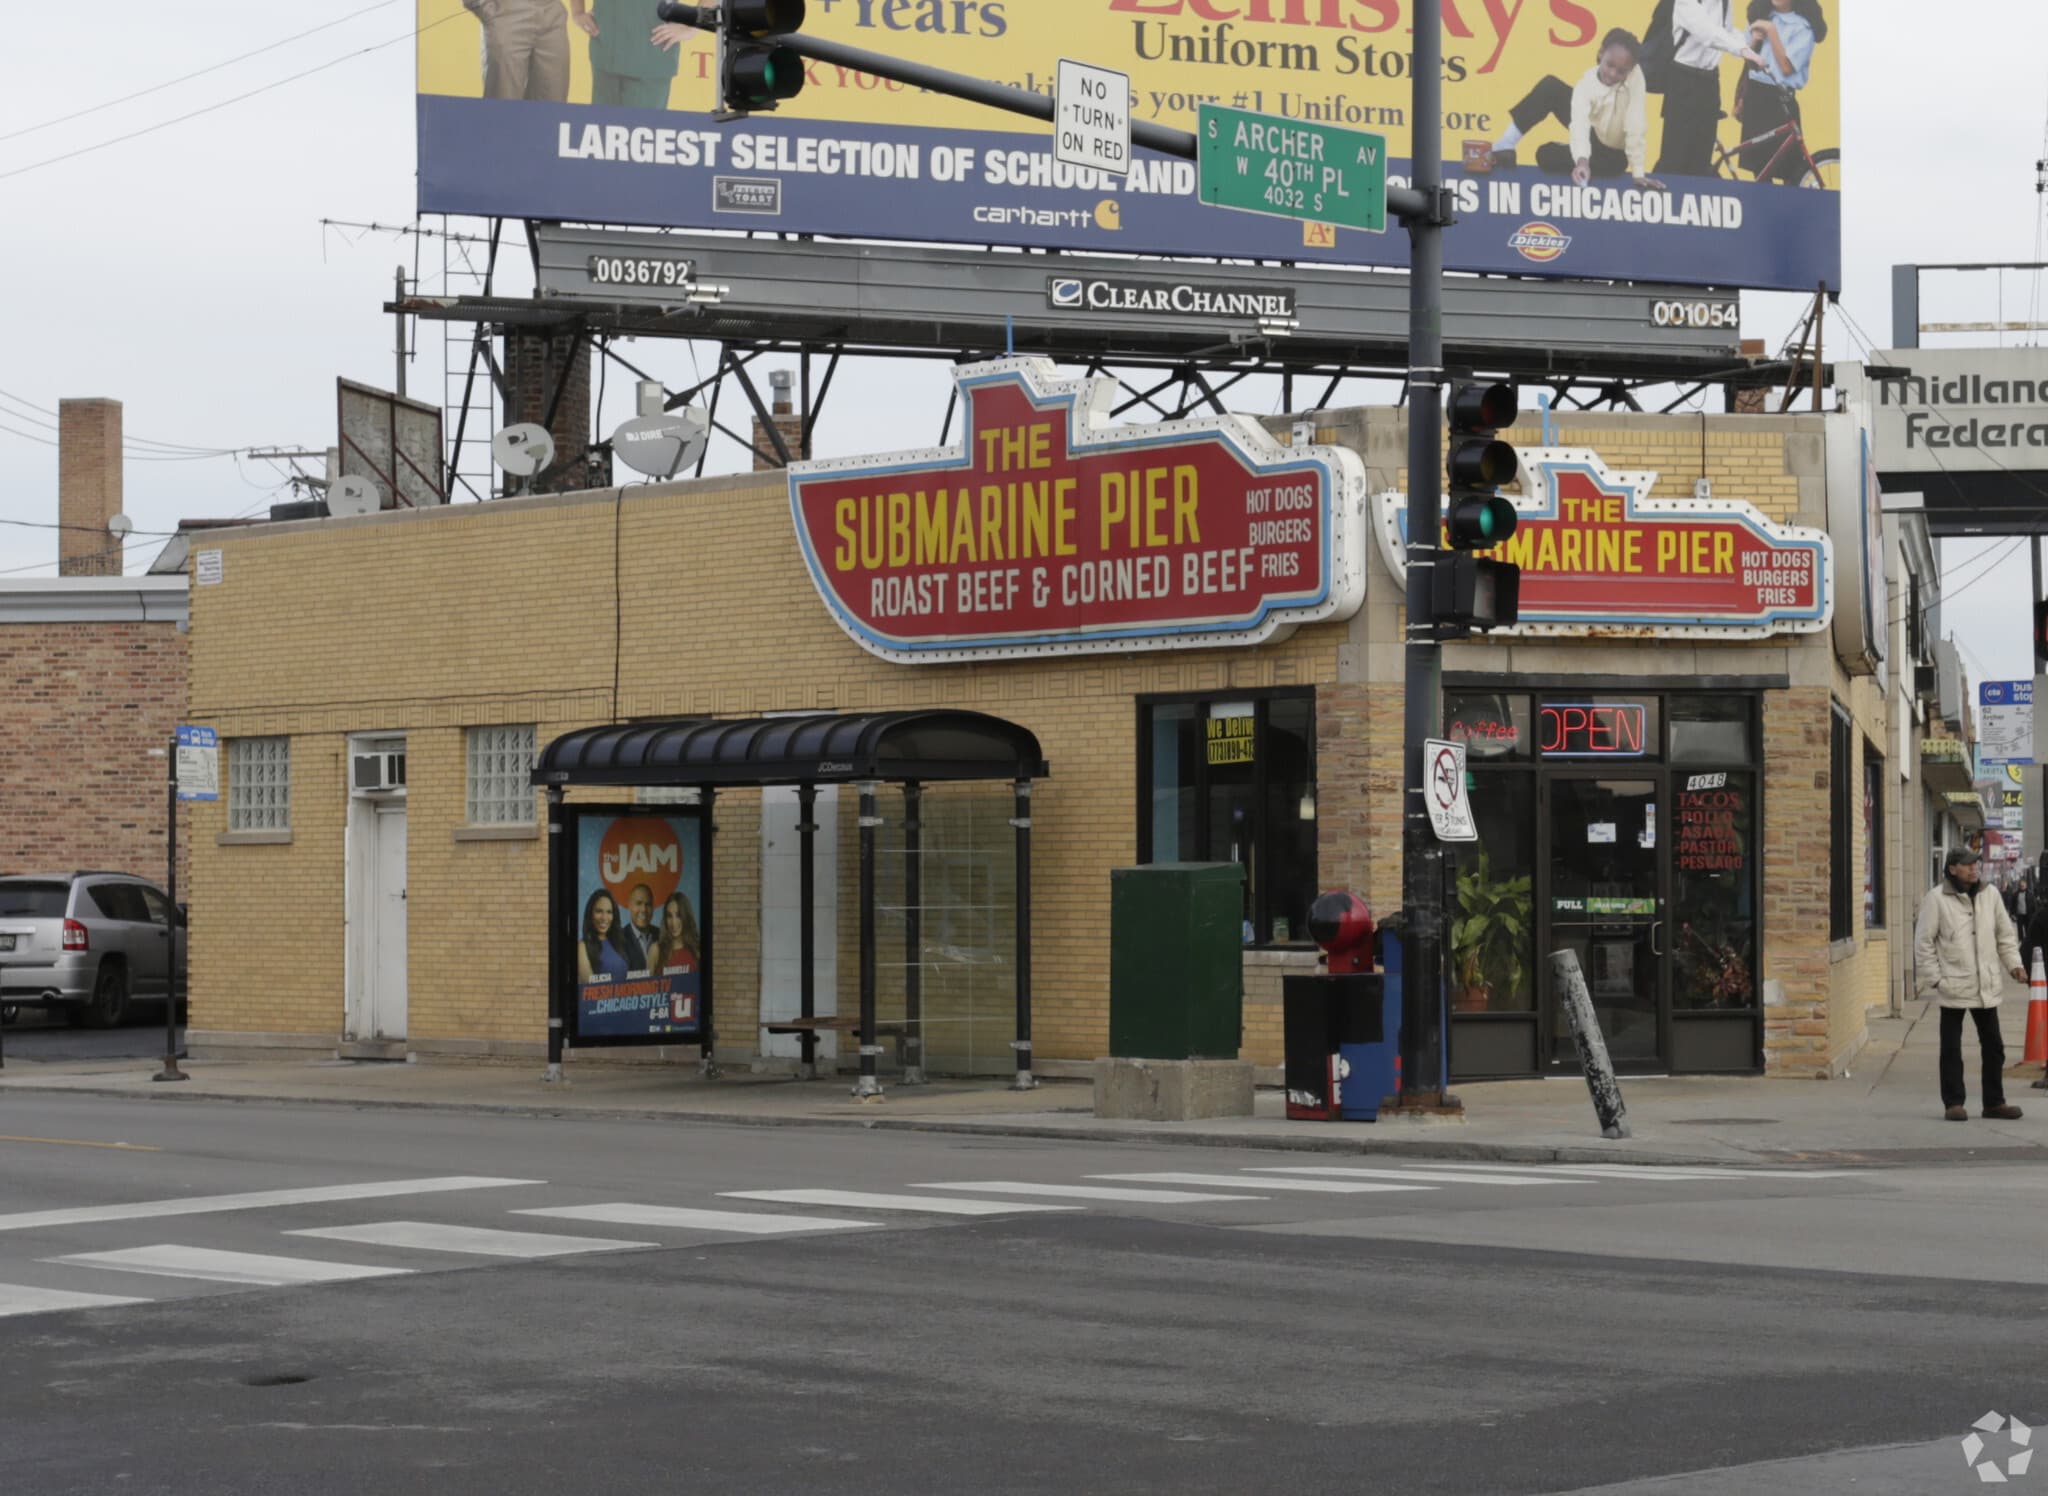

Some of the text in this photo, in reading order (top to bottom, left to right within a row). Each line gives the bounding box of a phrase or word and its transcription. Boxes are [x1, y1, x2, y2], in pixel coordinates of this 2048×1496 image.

[1132, 19, 1467, 82] Uniform Stos
[1080, 77, 1107, 100] NO
[1072, 103, 1115, 131] TURN
[1232, 90, 1263, 112] #1
[1280, 93, 1405, 126] Uniform
[1441, 110, 1491, 132] ore
[1062, 131, 1123, 161] ON RED
[1208, 119, 1377, 166] S ARCHER AV
[558, 122, 1196, 196] LARGEST SELECTION OF SCHOOL AND
[1236, 155, 1249, 176] W
[1263, 157, 1314, 188] 40TH
[1322, 166, 1350, 198] PL
[1263, 185, 1323, 213] 4032 S
[1488, 180, 1521, 215] IN
[1531, 183, 1743, 229] CHICAGOLAND
[973, 205, 1092, 229] carhartt
[1515, 235, 1566, 248] Dickies
[596, 258, 689, 286] 0036792
[1653, 301, 1738, 328] 001054
[980, 422, 1052, 474] THE
[1246, 484, 1313, 514] HOT DOGS
[1562, 498, 1622, 523] THE
[834, 464, 1201, 572] SUBMARINE PIER
[1249, 518, 1312, 547] BURGERS
[1441, 526, 1735, 574] MARINE PIER
[1741, 549, 1811, 569] HOT DOGS
[1261, 551, 1300, 579] FRIES
[1742, 568, 1809, 587] BURGERS
[871, 546, 1256, 618] ROAST BEEF & CORNED BEEF
[1757, 587, 1797, 605] FRIES
[2012, 682, 2033, 693] bus
[1206, 717, 1223, 739] We
[1450, 720, 1520, 741] Coffee
[1541, 707, 1642, 751] OPEN
[1688, 773, 1725, 789] 4048
[1678, 791, 1743, 810] TACOS
[602, 842, 678, 884] JAM
[1556, 900, 1584, 910] PULL
